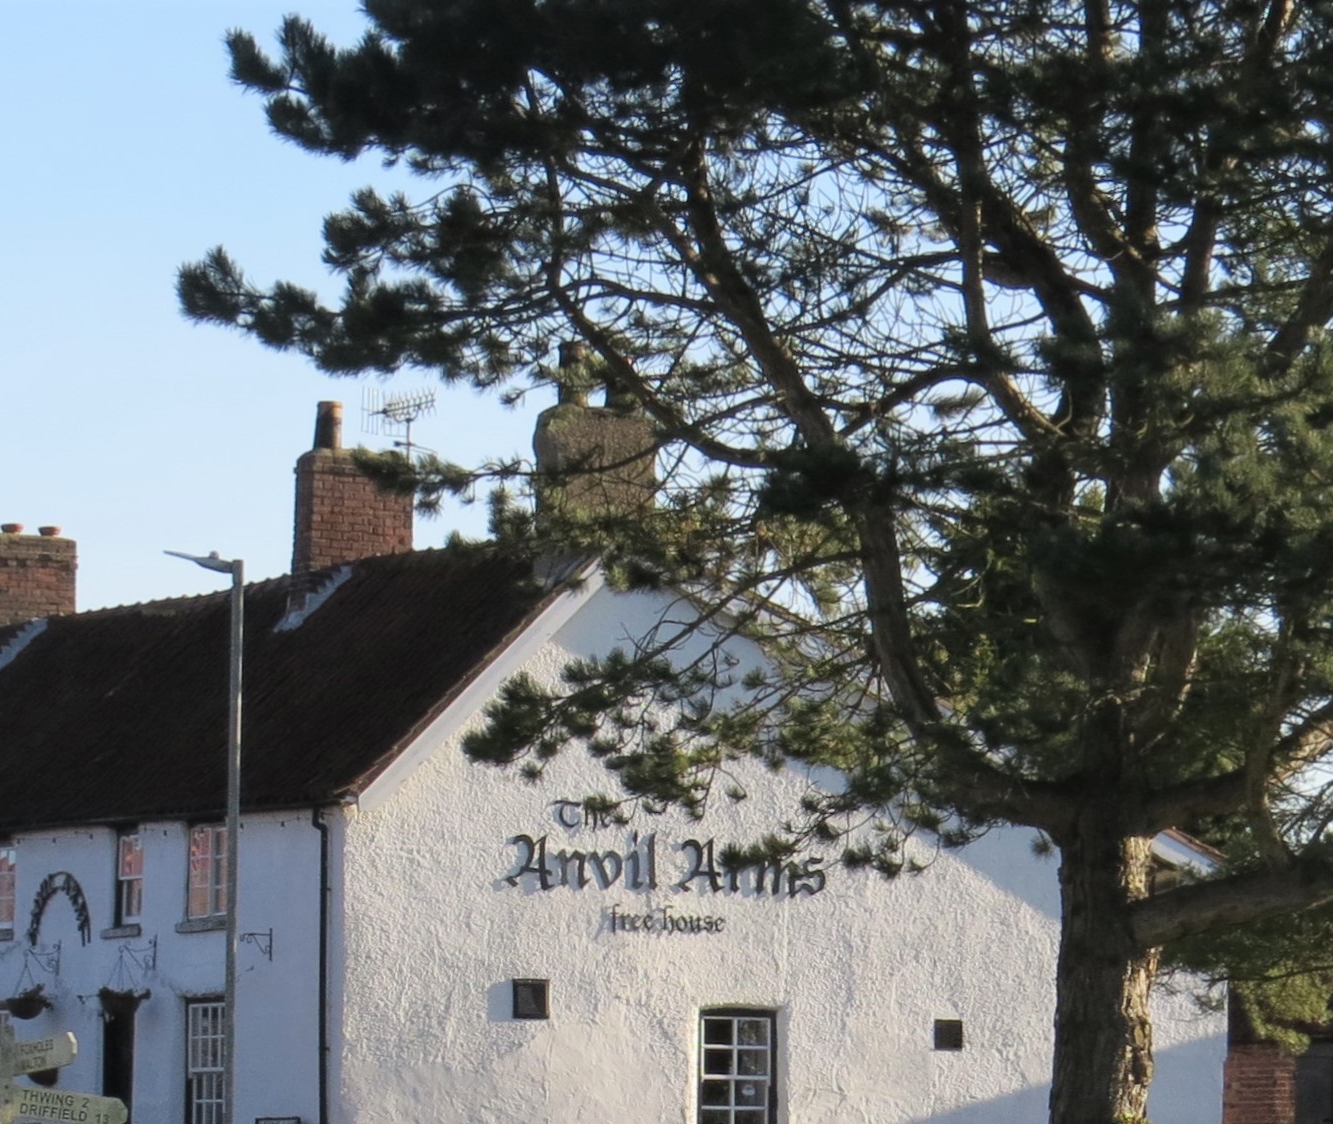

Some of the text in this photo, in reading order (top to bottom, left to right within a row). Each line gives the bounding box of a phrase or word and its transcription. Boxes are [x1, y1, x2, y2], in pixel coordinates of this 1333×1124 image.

[506, 830, 827, 898] Anvil Arms
[610, 903, 726, 935] free house
[22, 1089, 90, 1109] THWING 2
[19, 1103, 88, 1122] DRIFFIELD
